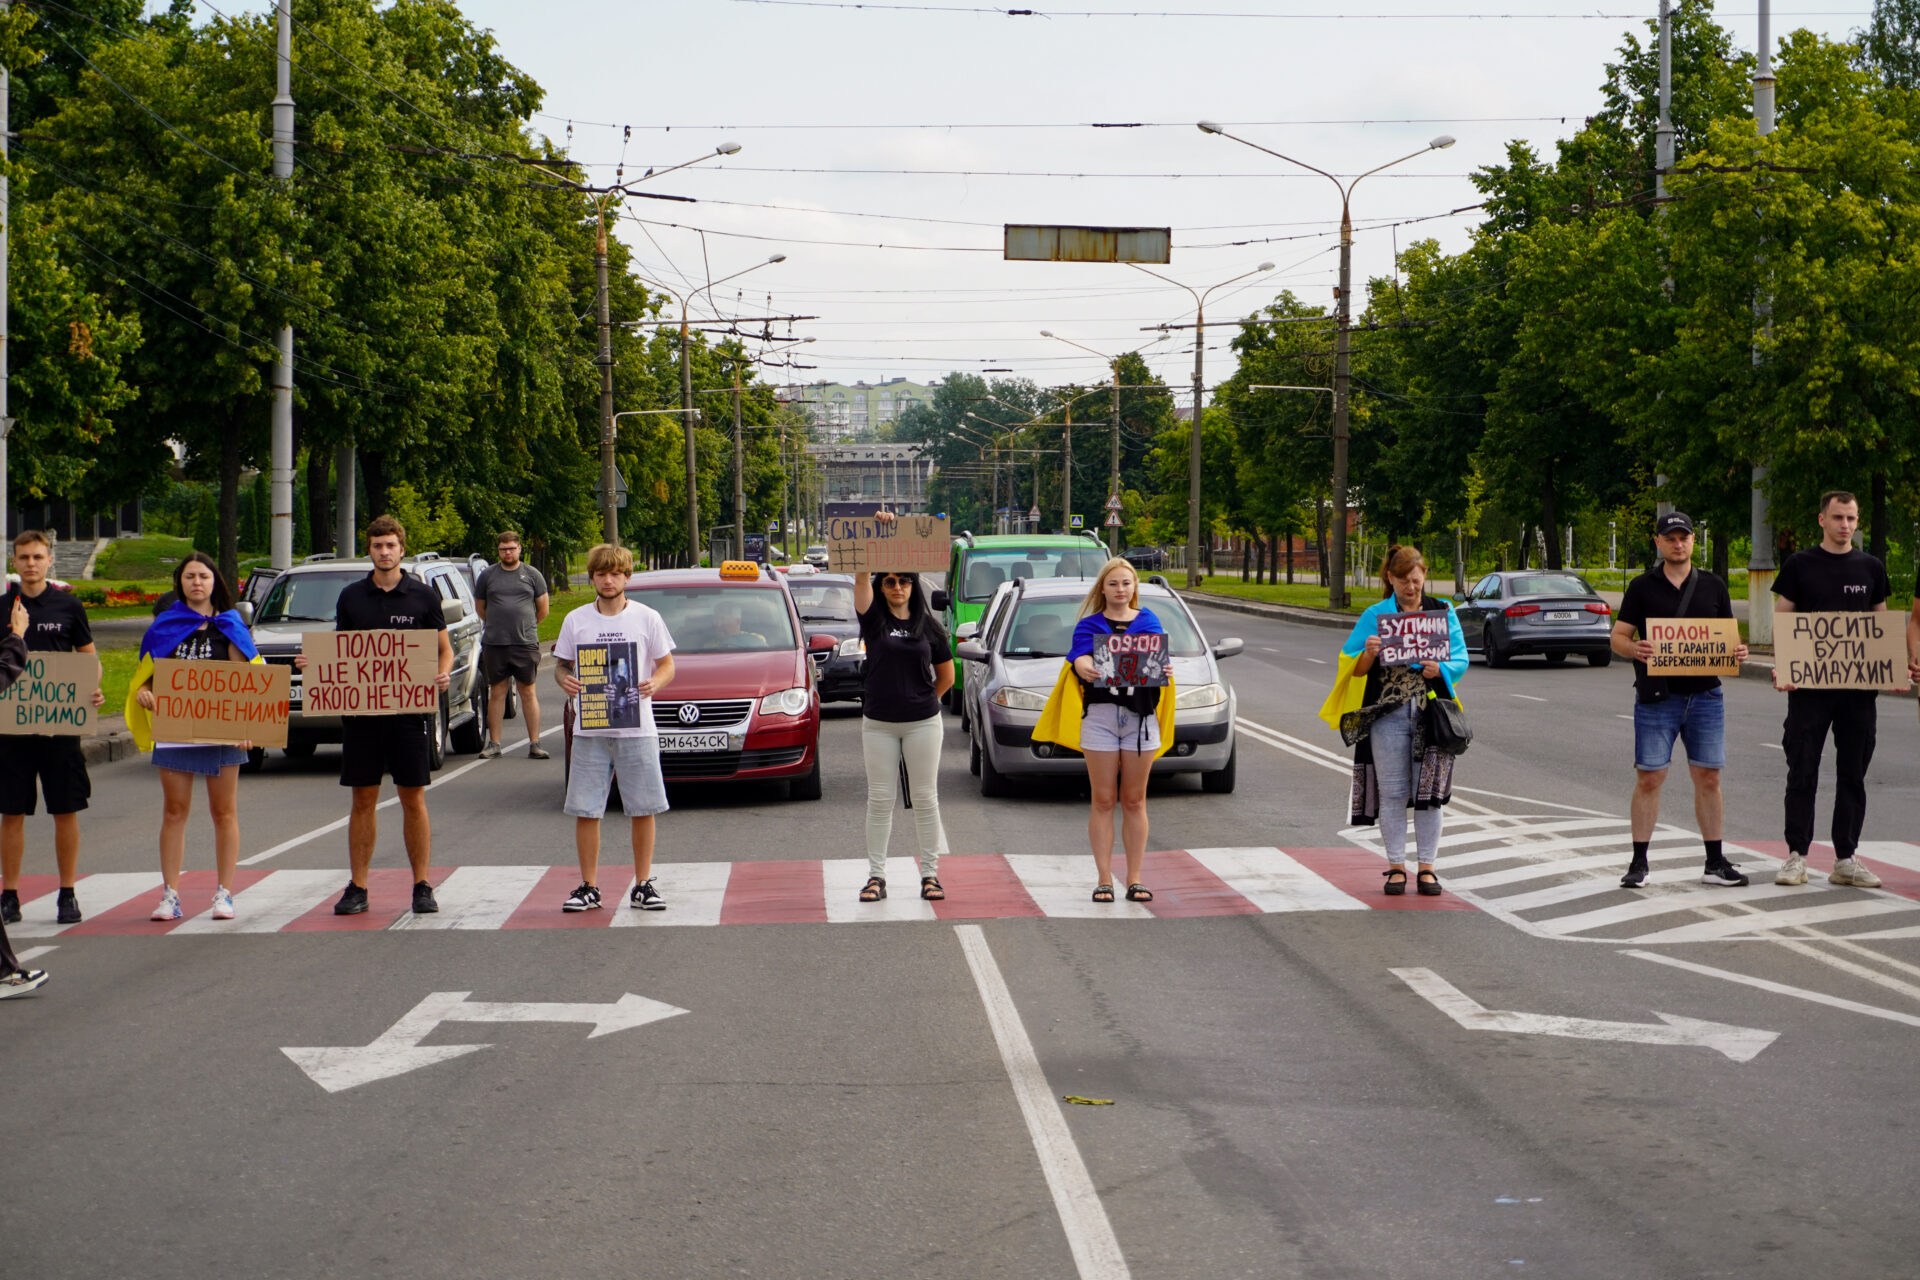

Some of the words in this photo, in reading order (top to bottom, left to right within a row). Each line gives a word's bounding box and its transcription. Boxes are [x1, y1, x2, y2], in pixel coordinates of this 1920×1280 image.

[831, 518, 898, 540] СВОБОДУ
[1380, 617, 1448, 639] ЗУПИНИ
[1652, 624, 1710, 641] ПОЛОН
[1793, 615, 1884, 640] ДОСИТЬ
[1107, 633, 1162, 654] 09:00
[1660, 642, 1674, 654] НЕ
[1679, 641, 1726, 654] ГАРАНТІЯ
[1815, 640, 1865, 660] БУТИ
[578, 649, 607, 666] ВОРОГ
[1652, 656, 1706, 667] ЗБЕРЕЖЕННЯ
[1708, 656, 1738, 667] ЖИТТЯ.
[171, 668, 274, 696] СВОБОДУ
[318, 661, 348, 685] ЦЕ
[357, 658, 412, 683] КРИК
[1790, 658, 1894, 685] БАЙДУЖИМ
[308, 685, 360, 711] ЯКОГО
[16, 703, 87, 727] ВІРИМО
[155, 695, 290, 725] ПОЛОНЕНИМ!!
[678, 735, 707, 748] 6434
